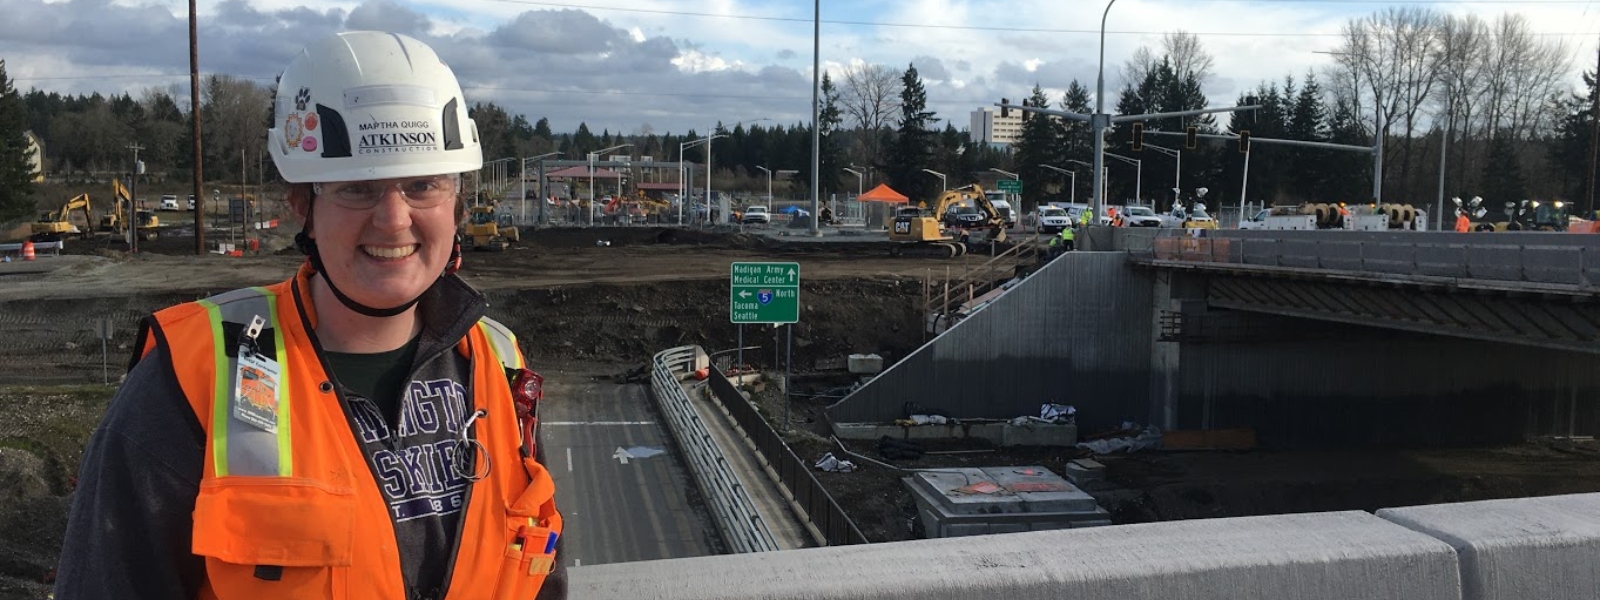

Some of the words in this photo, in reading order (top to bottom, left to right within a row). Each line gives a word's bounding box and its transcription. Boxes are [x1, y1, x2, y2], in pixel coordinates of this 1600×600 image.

[401, 120, 429, 129] QUIGG
[359, 132, 436, 147] ATKINSON
[358, 146, 438, 155] CONSTRUCTION
[895, 221, 910, 233] CAT
[734, 265, 762, 275] Madigan
[766, 265, 785, 275] Army
[734, 275, 759, 284] Medical
[763, 275, 785, 284] Center
[762, 293, 769, 303] 5
[775, 289, 796, 298] North
[734, 301, 759, 310] Tacoma
[734, 311, 758, 320] Seattle
